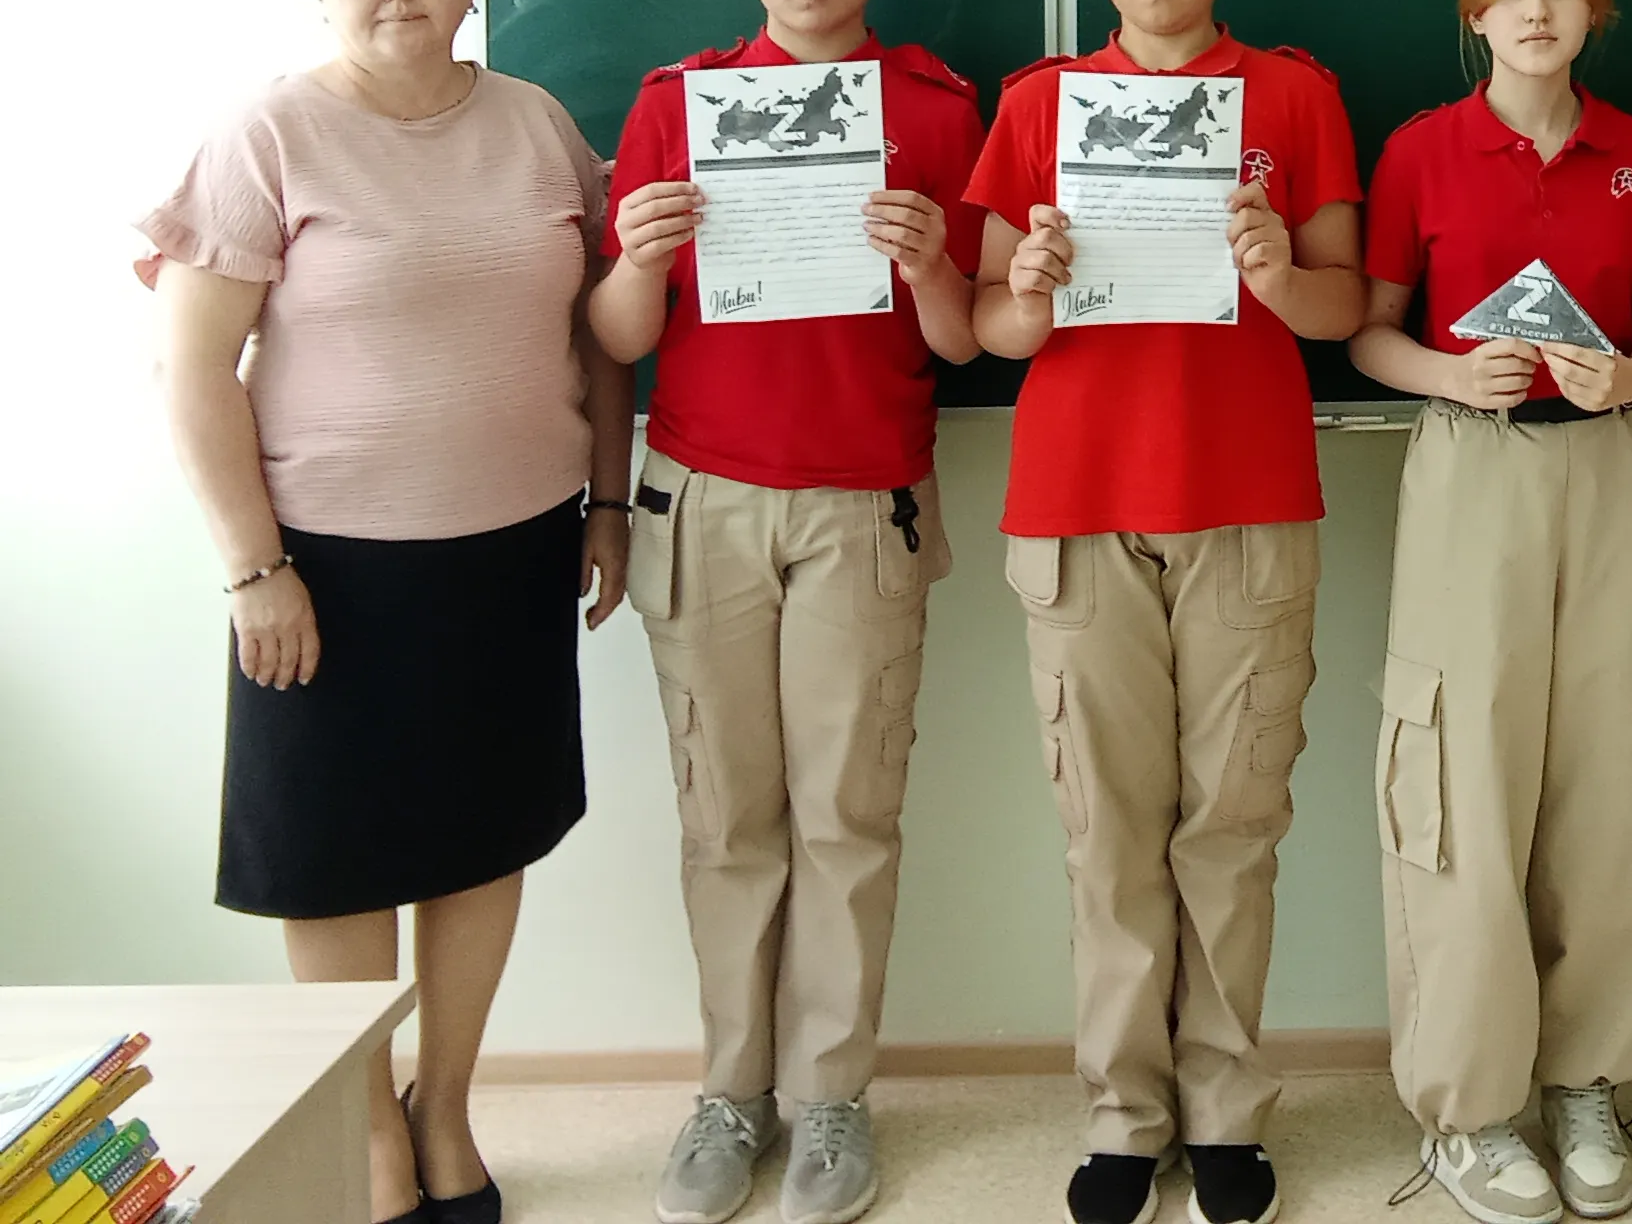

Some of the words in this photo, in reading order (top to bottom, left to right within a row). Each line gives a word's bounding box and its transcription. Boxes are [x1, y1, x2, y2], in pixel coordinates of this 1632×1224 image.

[769, 104, 806, 142] Z
[1133, 114, 1170, 151] Z
[1507, 275, 1553, 326] Z
